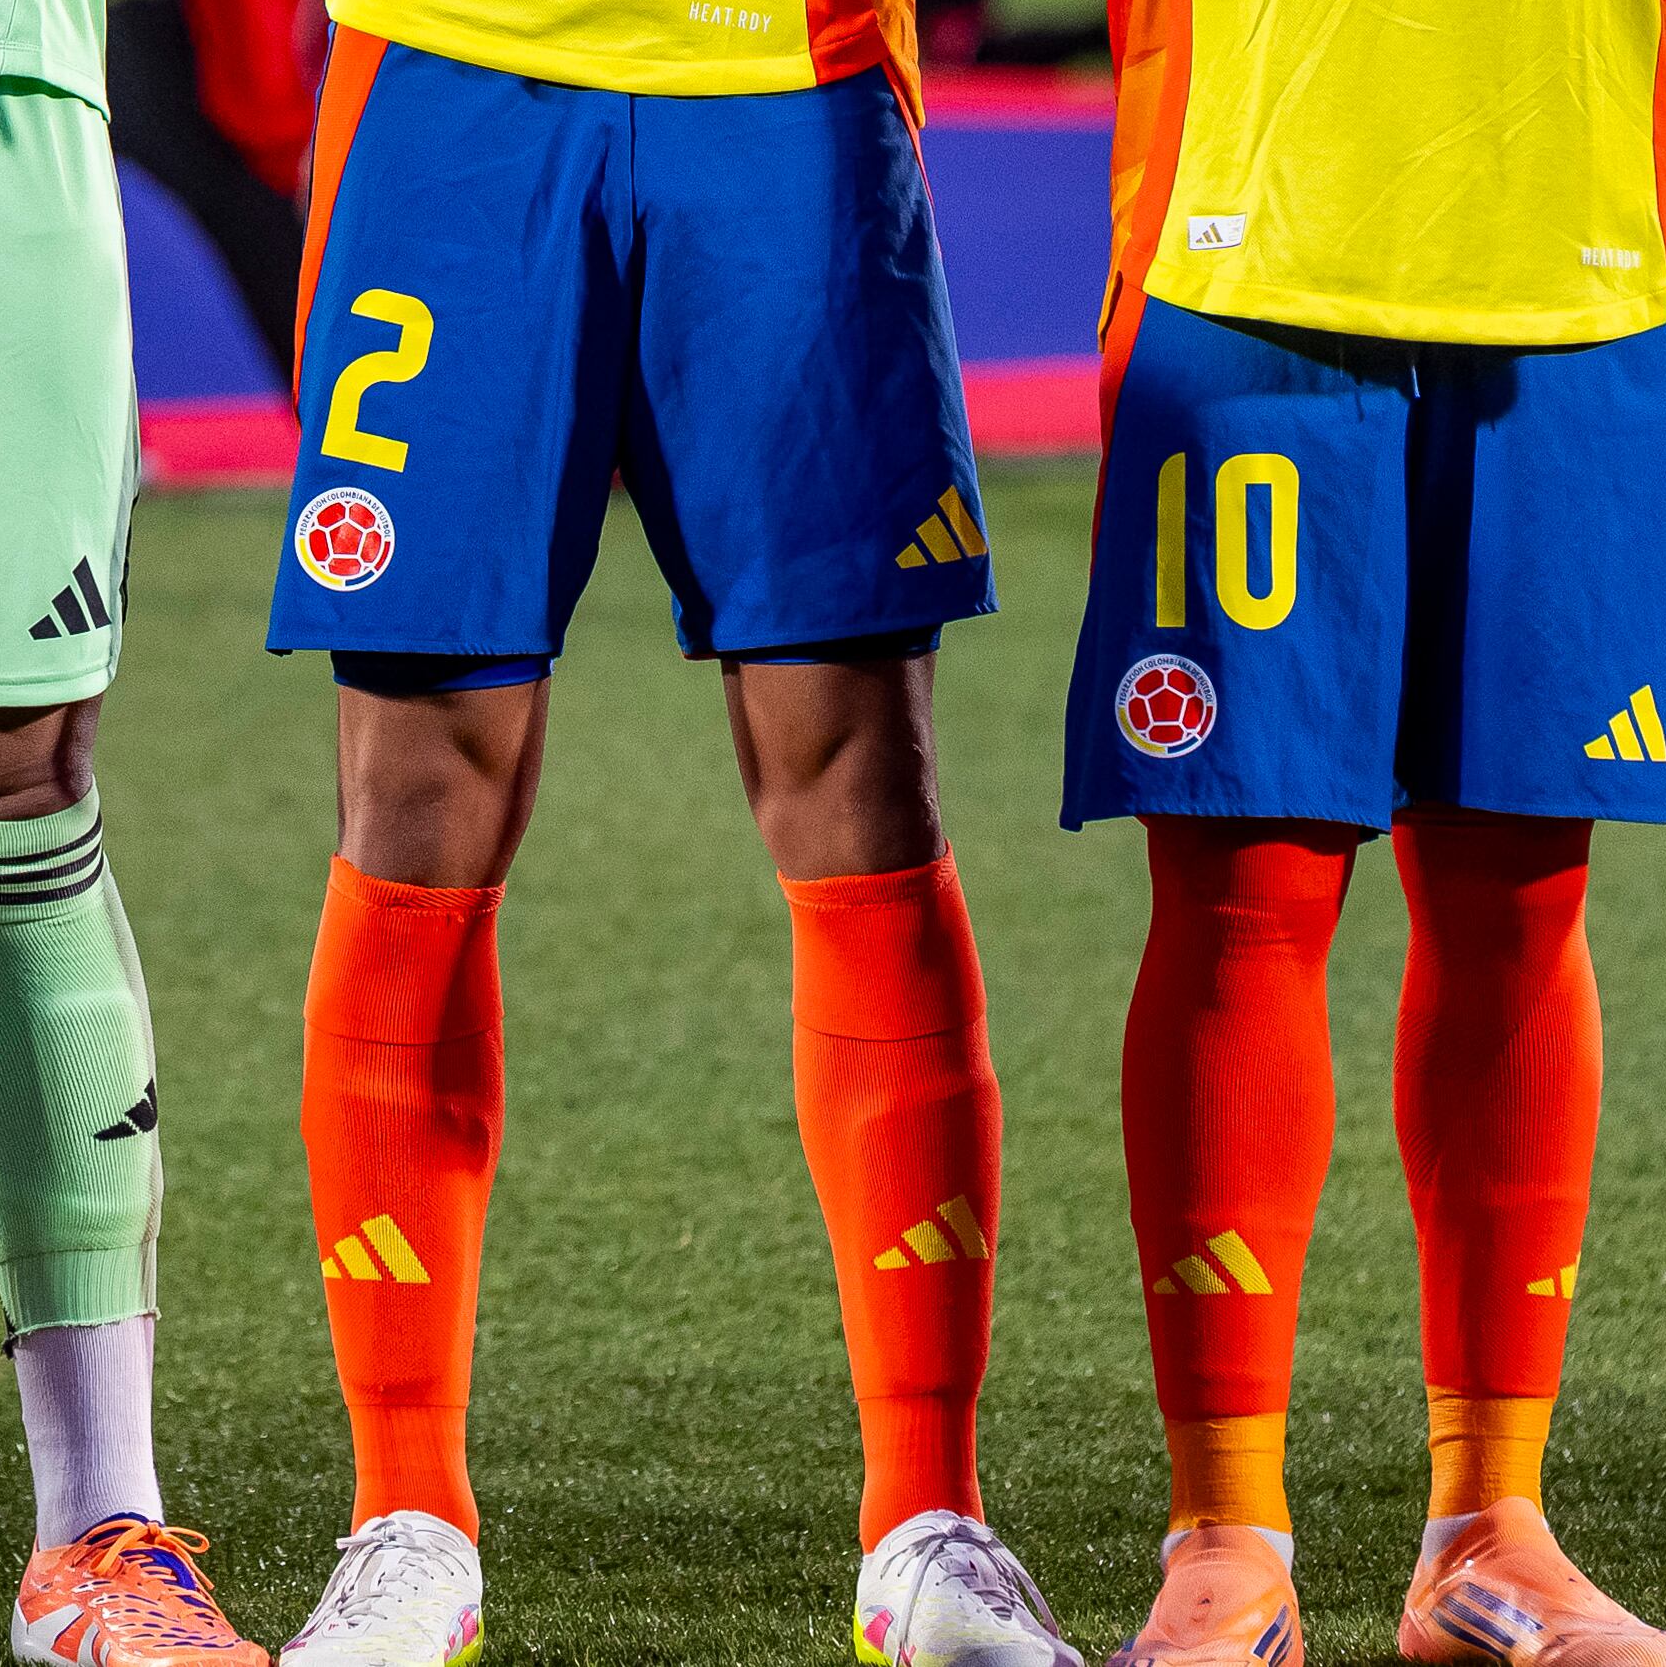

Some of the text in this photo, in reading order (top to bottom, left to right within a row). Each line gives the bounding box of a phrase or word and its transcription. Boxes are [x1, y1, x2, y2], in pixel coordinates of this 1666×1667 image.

[688, 0, 772, 34] HEAT.RDY
[321, 288, 435, 472] 2
[1155, 452, 1300, 631] 10
